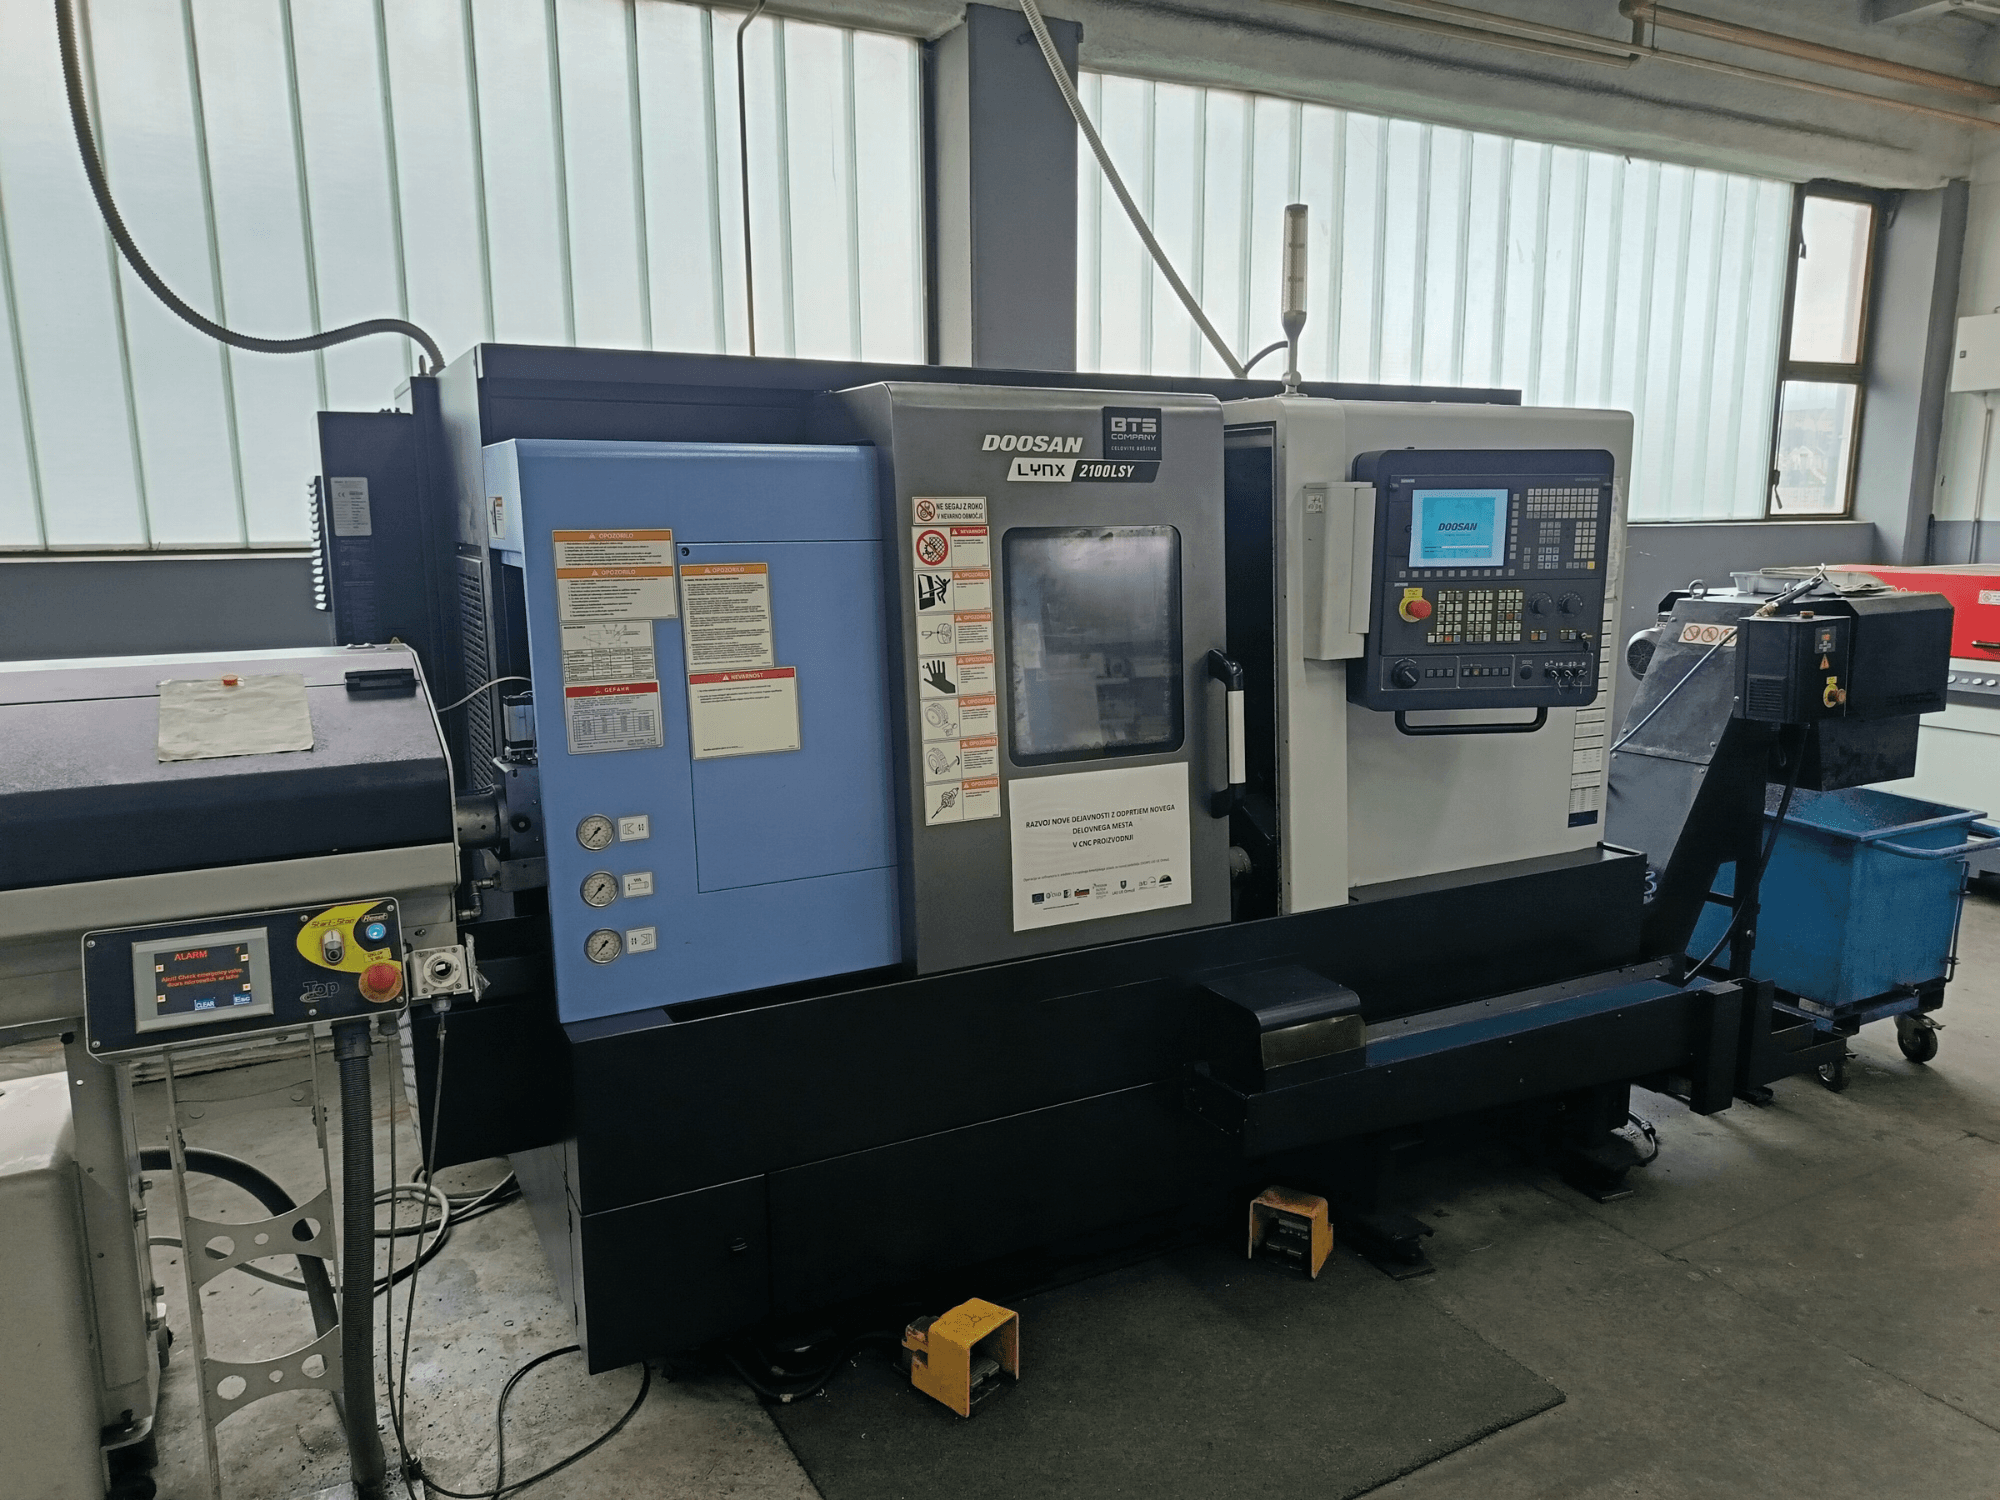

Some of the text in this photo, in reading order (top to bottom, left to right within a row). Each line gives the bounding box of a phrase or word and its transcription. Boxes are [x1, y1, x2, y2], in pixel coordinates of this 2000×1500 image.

[1111, 417, 1157, 433] BTS
[982, 434, 1083, 453] DOOSAN
[1079, 464, 1135, 478] 2100LSY
[1438, 523, 1477, 531] DOOSAN
[1025, 818, 1051, 828] RAZVOJ
[1051, 816, 1071, 825] NOVE
[1071, 812, 1110, 823] DEJAVNOSTI
[1116, 808, 1149, 817] ODPRTJEM
[1150, 804, 1176, 813] NOVEGA
[1072, 821, 1134, 835] DELOVNEGA MESTA
[1078, 839, 1092, 848] CNC
[1093, 834, 1134, 846] PROIZVODNJI
[174, 950, 208, 961] ALARM
[196, 1001, 215, 1009] CLEAR
